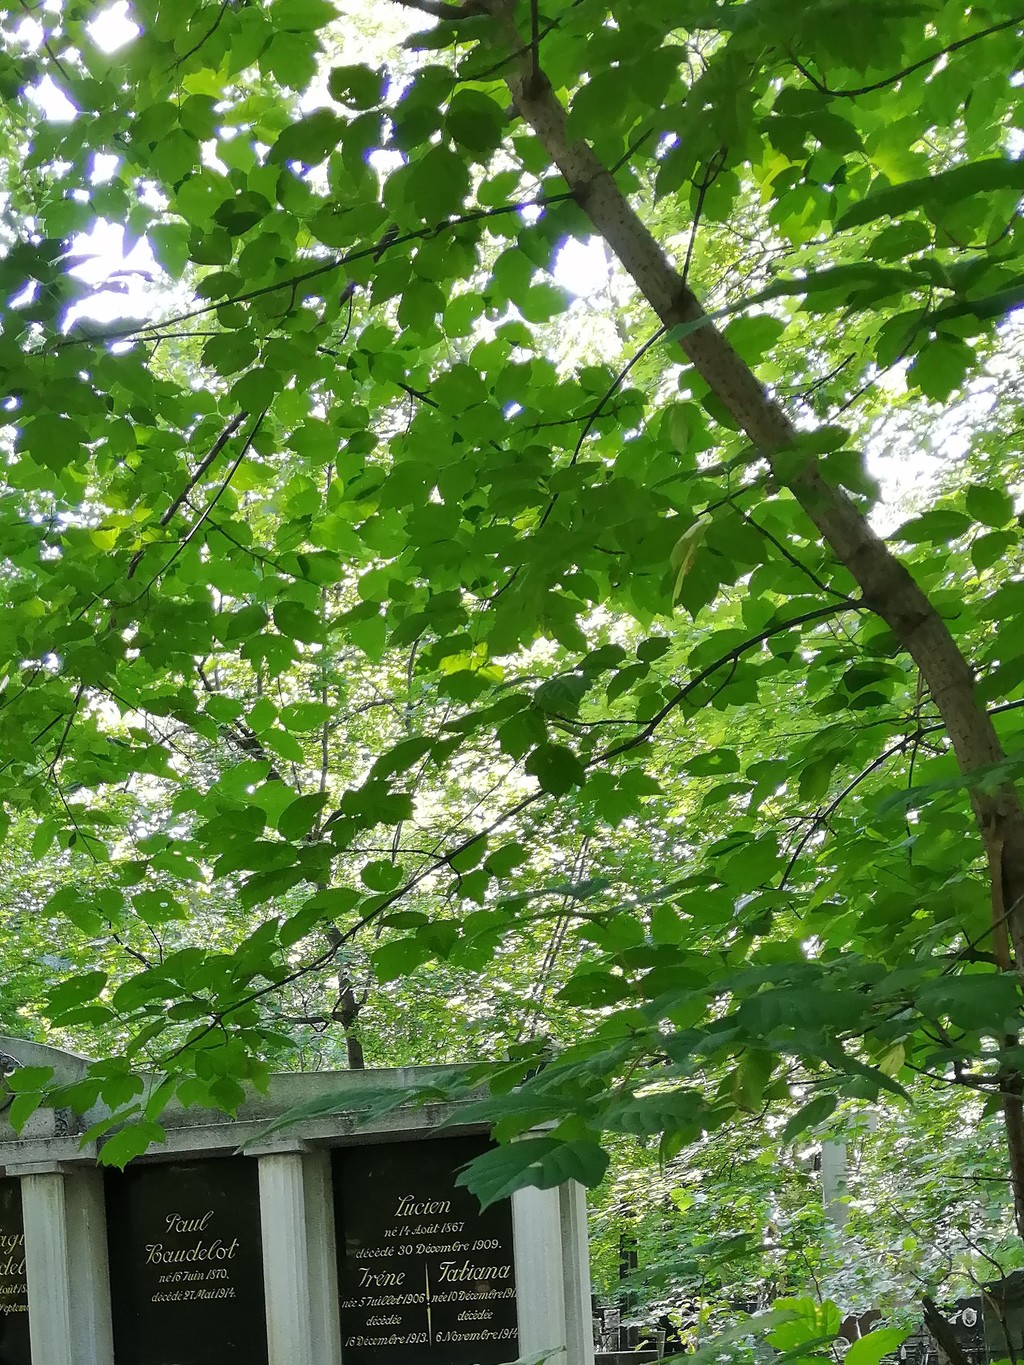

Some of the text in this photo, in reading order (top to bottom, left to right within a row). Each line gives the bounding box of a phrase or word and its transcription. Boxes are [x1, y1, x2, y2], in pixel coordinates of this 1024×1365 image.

[394, 1194, 451, 1217] Lucien
[165, 1210, 214, 1234] Paul
[440, 1221, 466, 1234] 1867
[145, 1237, 240, 1265] Baudelot
[397, 1244, 413, 1256] 30
[415, 1240, 470, 1256] Décembre
[438, 1259, 511, 1283] Tatiana
[402, 1292, 425, 1305] 1906
[344, 1336, 357, 1348] 16
